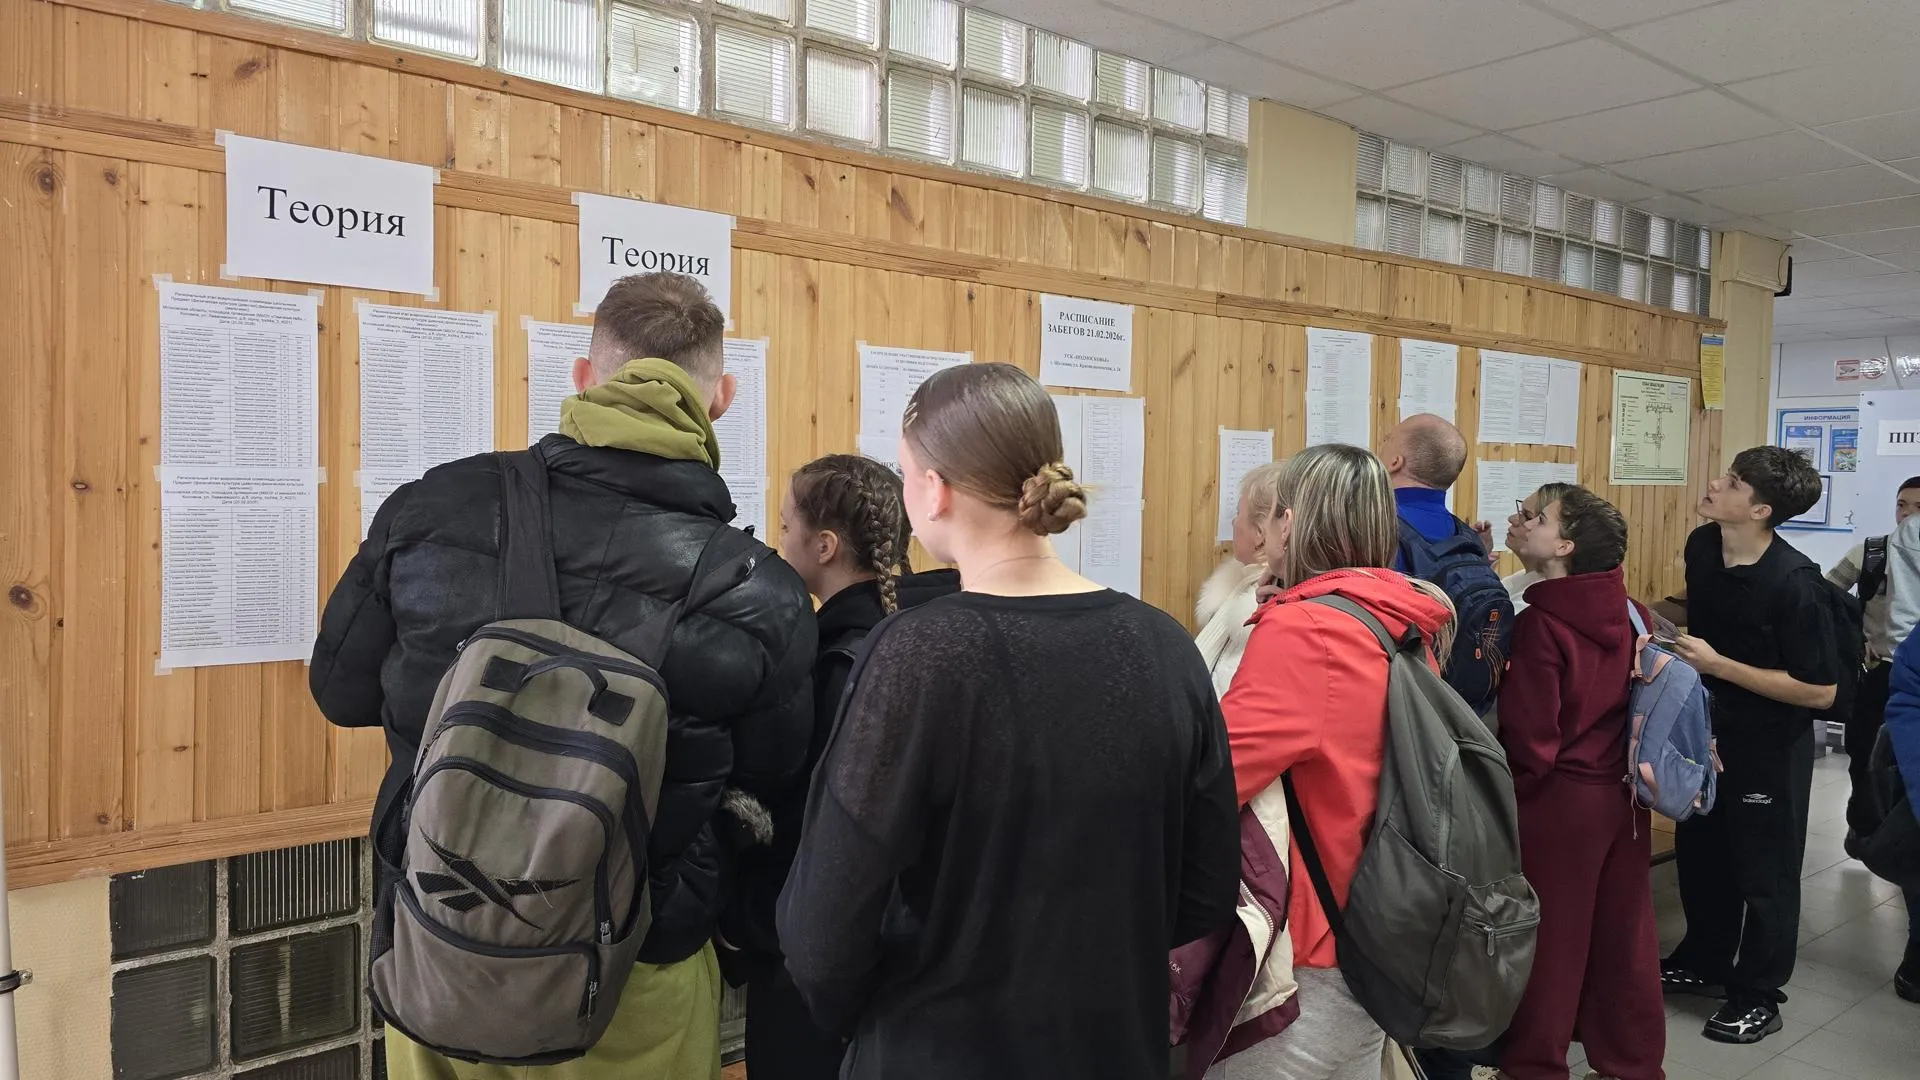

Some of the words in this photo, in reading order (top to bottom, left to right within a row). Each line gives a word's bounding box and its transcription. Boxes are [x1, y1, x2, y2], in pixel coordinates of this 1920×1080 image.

[257, 185, 406, 239] Теория
[601, 236, 710, 276] Теория
[1048, 323, 1085, 336] ЗАБЕГОВ
[1086, 328, 1126, 341] 21.02.2026г.
[1059, 311, 1116, 327] РАСПИСАНИЕ
